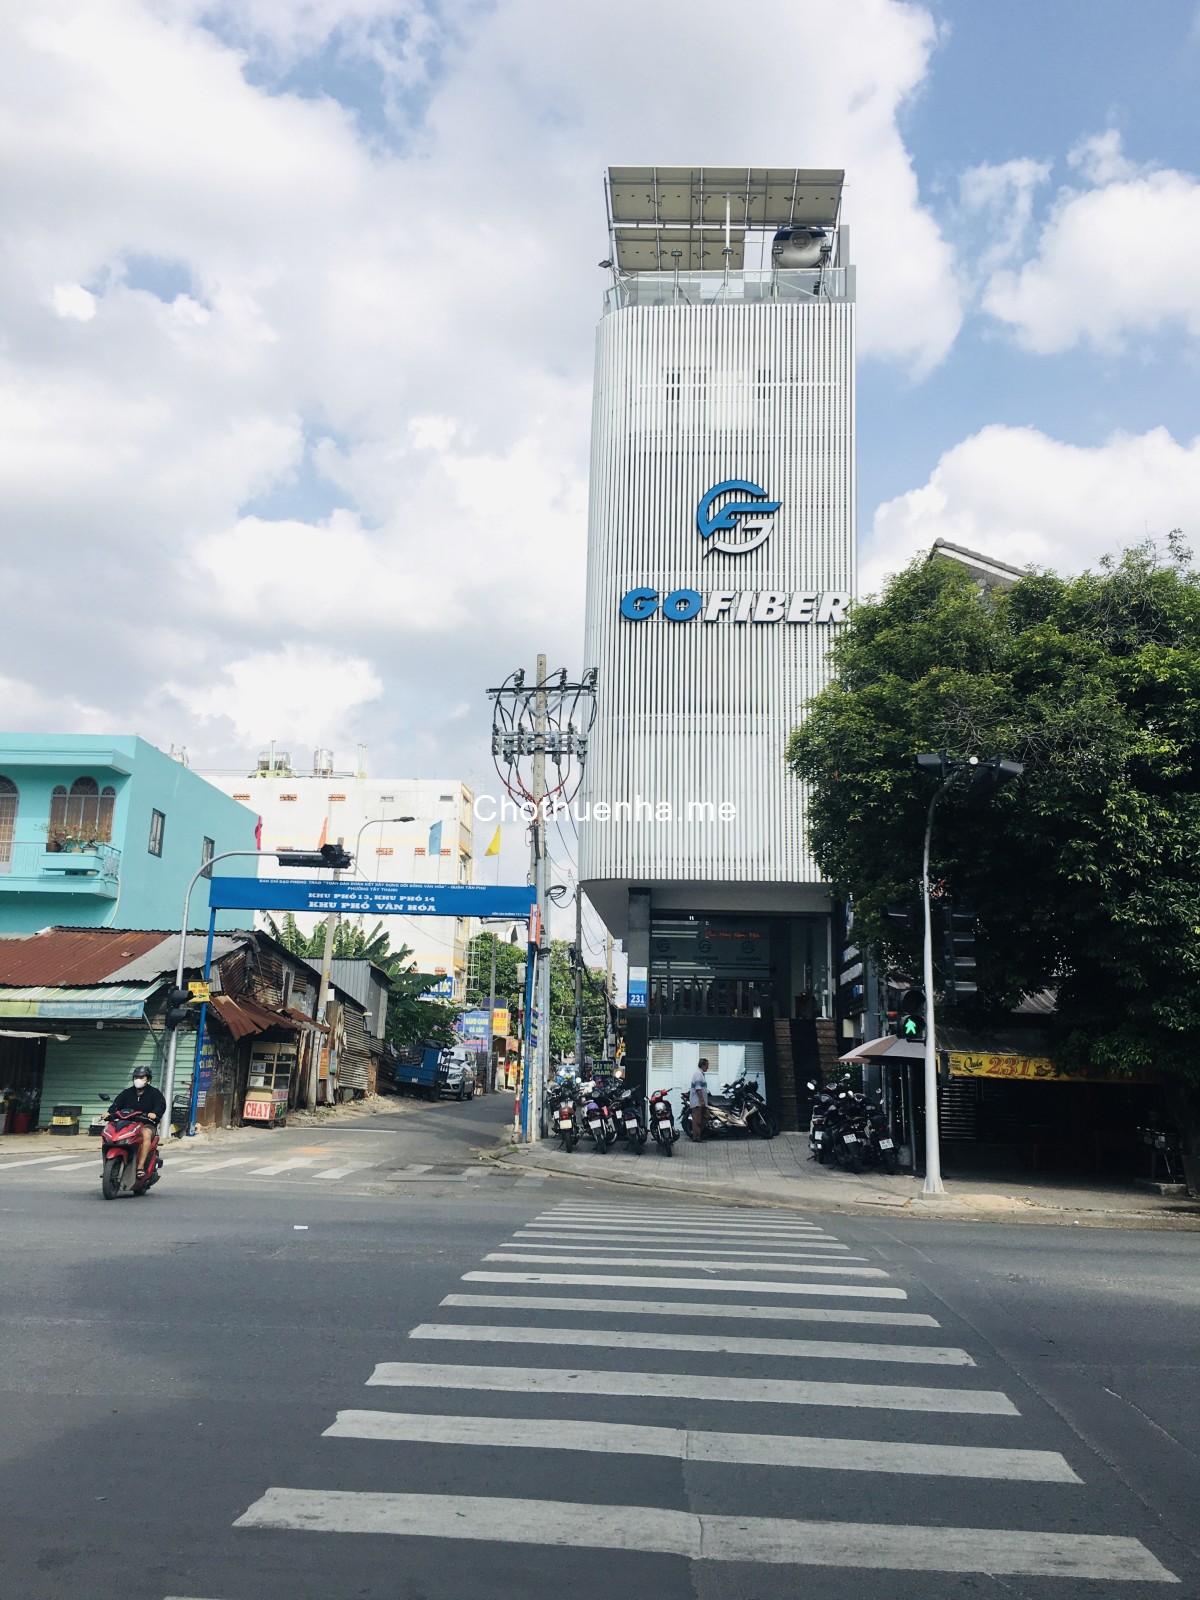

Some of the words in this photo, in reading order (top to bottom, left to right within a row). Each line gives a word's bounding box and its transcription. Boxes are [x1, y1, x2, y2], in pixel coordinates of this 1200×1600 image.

[620, 587, 851, 623] GOFIBER
[333, 892, 357, 900] PHỐ
[399, 894, 422, 902] PHỐ
[308, 901, 337, 909] KHU
[340, 900, 370, 910] PHỐ
[376, 901, 404, 911] VĂN
[407, 903, 436, 912] HÓA
[630, 994, 645, 1004] 231
[985, 1056, 1032, 1077] 231
[245, 1102, 270, 1118] CHAY
